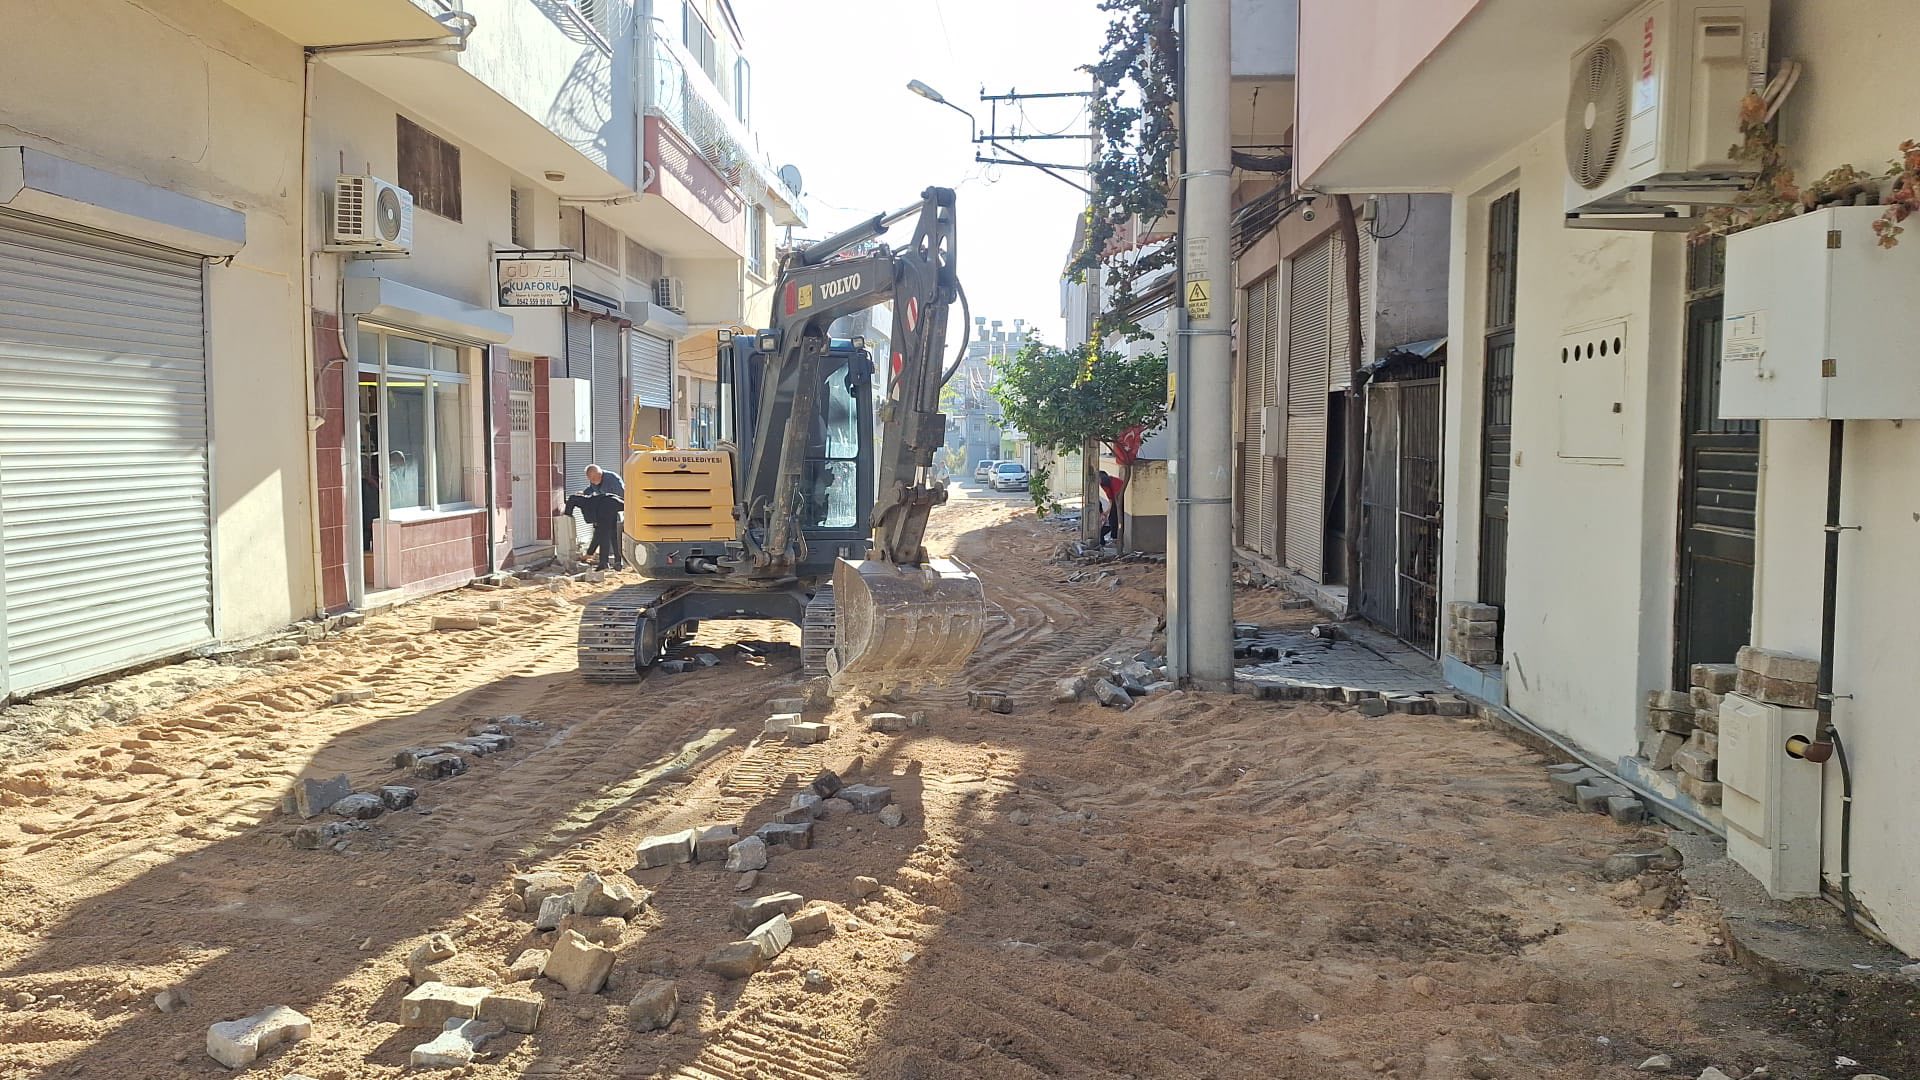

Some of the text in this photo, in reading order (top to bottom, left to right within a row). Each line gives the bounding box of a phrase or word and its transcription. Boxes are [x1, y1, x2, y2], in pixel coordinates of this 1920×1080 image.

[506, 262, 566, 278] GÜVEN
[509, 279, 559, 291] KUAFÖRÜ
[820, 273, 861, 300] VOLVO
